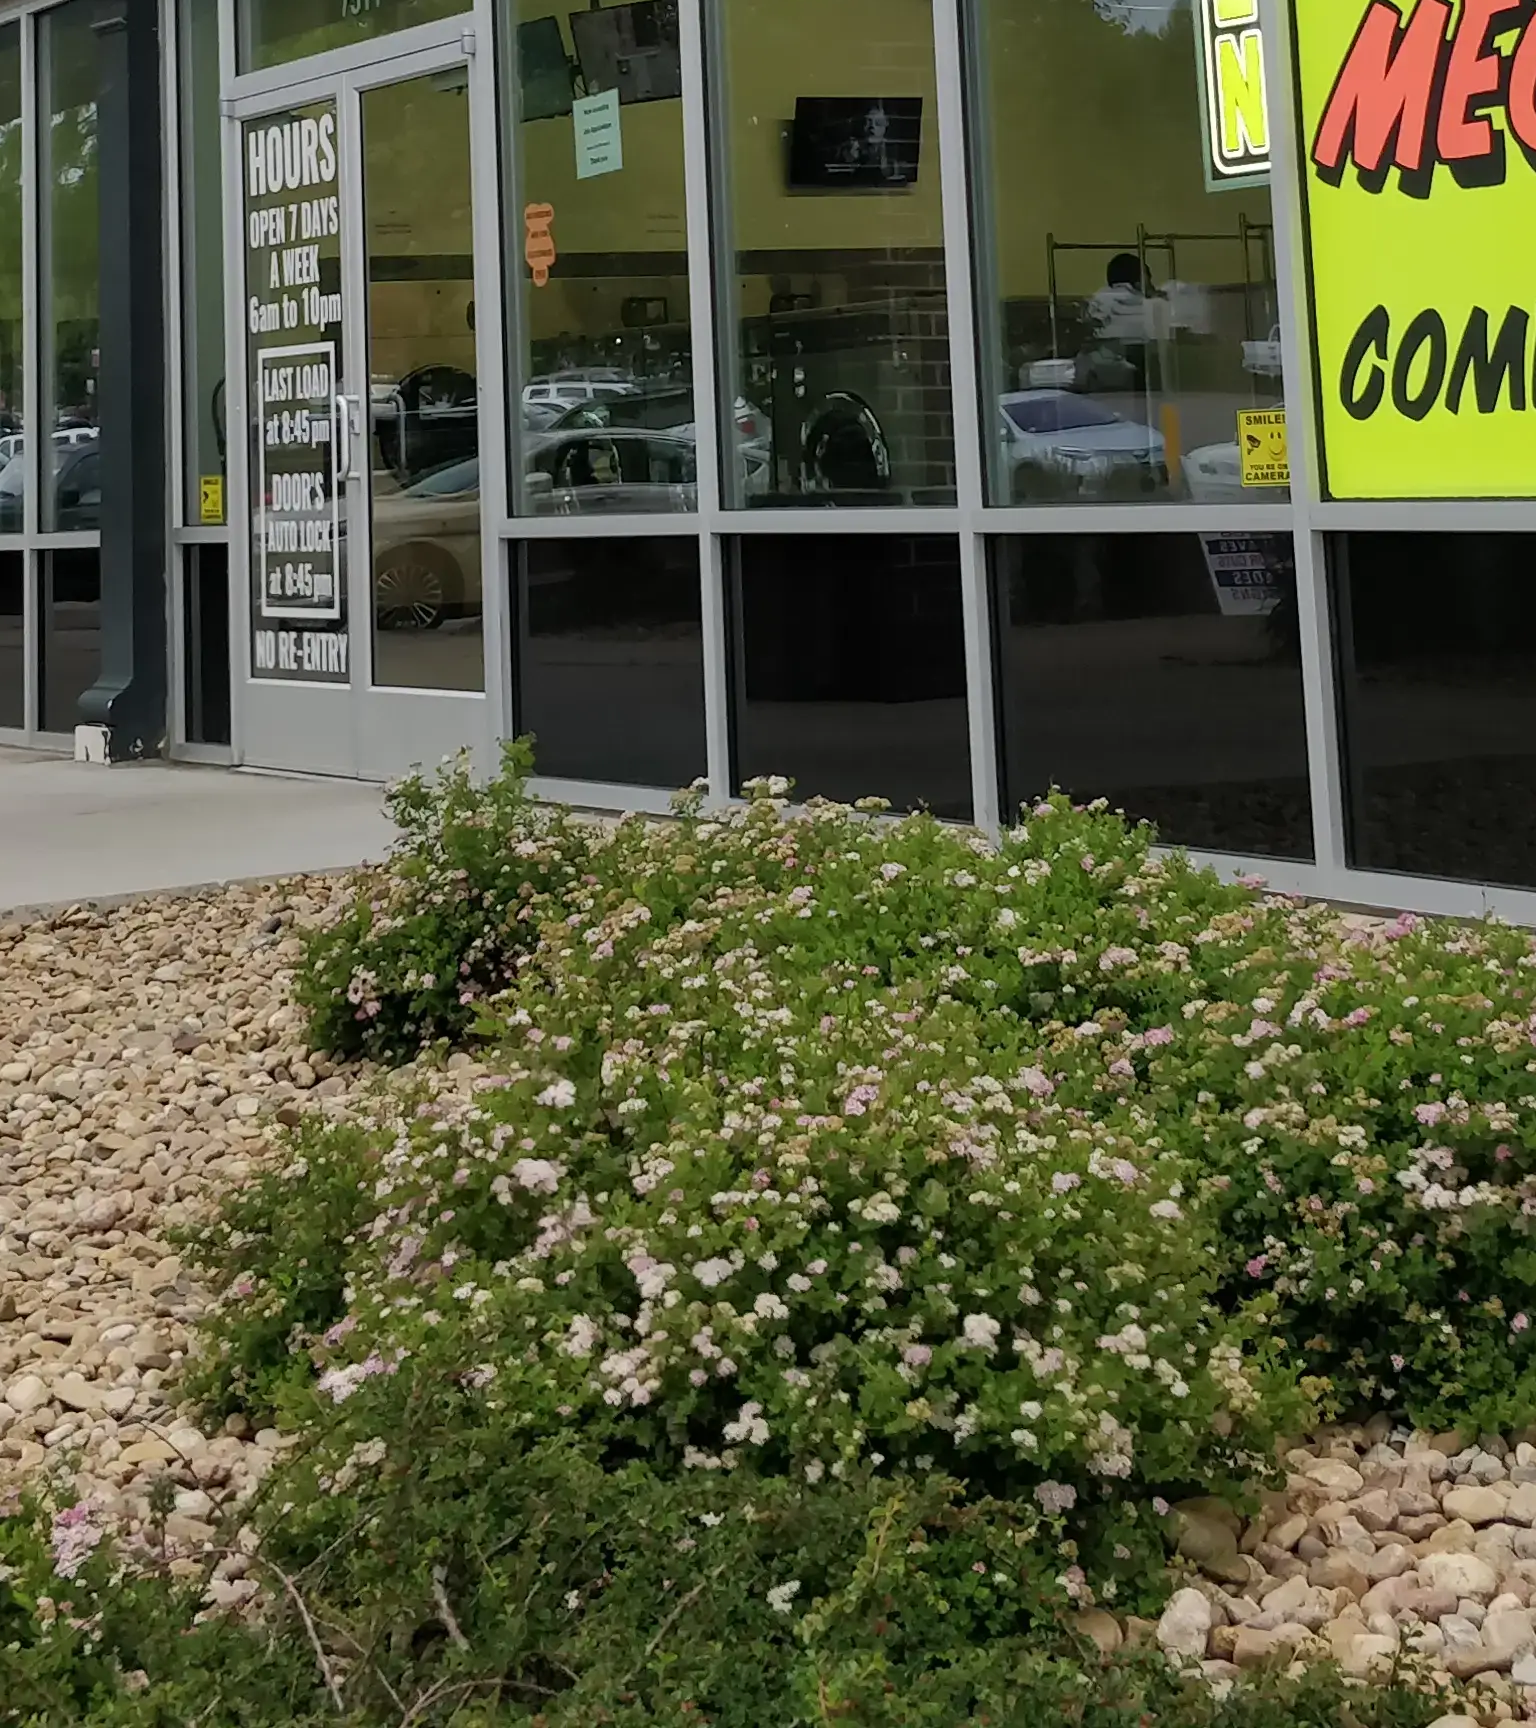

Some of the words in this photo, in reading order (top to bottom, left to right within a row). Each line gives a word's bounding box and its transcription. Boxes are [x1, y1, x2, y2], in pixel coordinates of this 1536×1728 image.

[248, 113, 336, 196] HOURS
[249, 206, 285, 249] OPEN
[288, 204, 298, 242] 7
[301, 196, 338, 240] DAYS
[270, 251, 280, 289] A
[283, 244, 320, 286] WEEK
[249, 296, 280, 334] 6am
[283, 293, 298, 328] to
[302, 286, 342, 332] 10pm
[264, 367, 294, 402] LAST
[295, 363, 328, 400] LOAD
[266, 414, 280, 445] at
[282, 410, 310, 445] 8:45
[311, 420, 330, 449] pm
[272, 471, 325, 511] DOOR'S
[268, 521, 298, 552] AUTO
[299, 520, 332, 553] LOCK
[269, 566, 282, 596] at
[284, 563, 312, 597] 8:45
[255, 630, 276, 670] NO
[278, 630, 348, 673] RE-ENTRY
